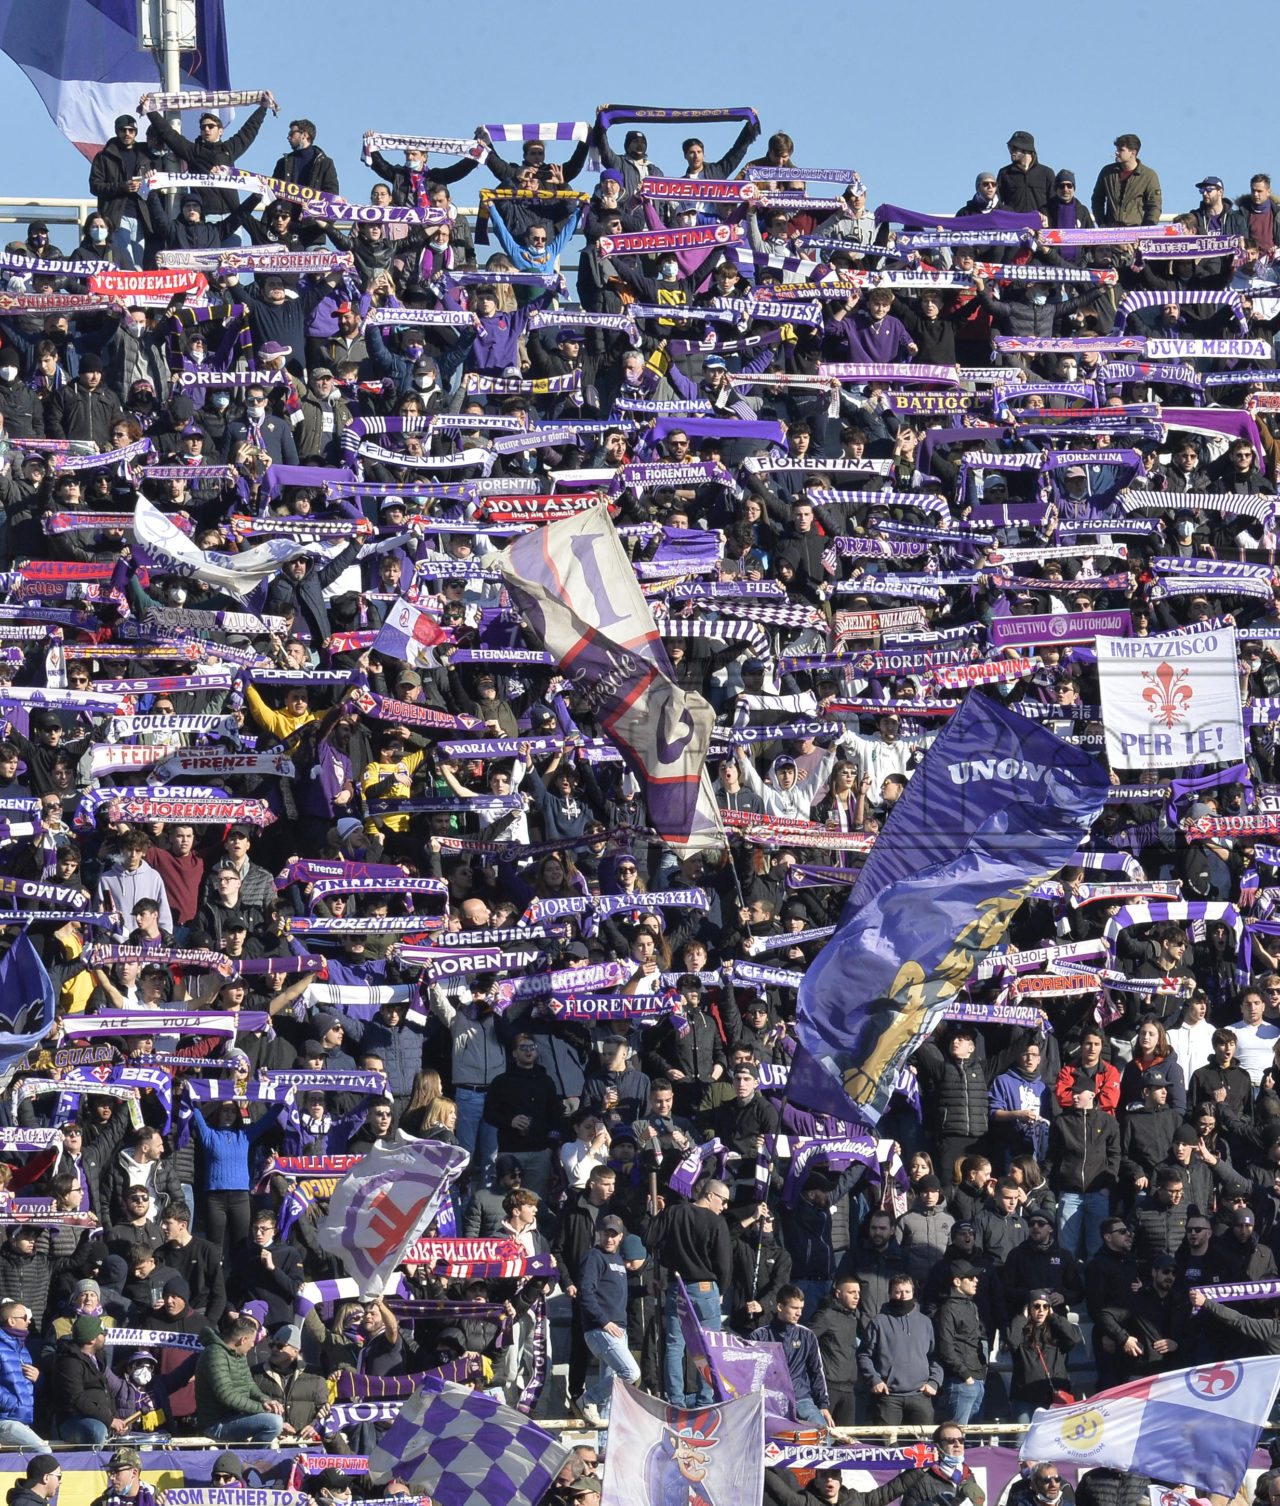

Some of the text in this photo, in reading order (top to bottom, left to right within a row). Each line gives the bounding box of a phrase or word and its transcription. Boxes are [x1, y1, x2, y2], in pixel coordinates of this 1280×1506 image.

[373, 136, 464, 154] FIORENTINA
[645, 181, 739, 199] FIORENTINA
[329, 204, 420, 223] VIOLA
[617, 230, 715, 249] FIORENTINA
[912, 231, 1019, 244] ACF FIORENTINA
[809, 236, 901, 256] ACF FIORENTINA
[1004, 264, 1091, 282] FIORENTINA
[441, 312, 473, 323] VIOLA
[1152, 340, 1265, 357] JUVE MERDA
[1206, 374, 1231, 384] ACF
[1008, 383, 1086, 394] FIORENTINA
[896, 396, 985, 409] BATIGOL
[366, 443, 466, 465] FIORENTINA
[1057, 453, 1123, 463] FIORENTINA
[757, 457, 874, 472] FIORENTINA
[632, 467, 706, 480] la FIORENTINA
[252, 519, 353, 533] COLLETTIVO
[1059, 519, 1152, 530] ACF FIORENTINA
[837, 581, 940, 598] ACF FIORENTINA
[997, 616, 1122, 636] COLLETTIVO AUTONOMO
[1110, 636, 1218, 657] IMPAZZISCO
[470, 649, 544, 661] ETERNAMENTE
[875, 649, 969, 669] FIORENTINA
[251, 669, 352, 680] FIORENTINA
[381, 701, 456, 724] FIORENTINA
[132, 714, 221, 730] COLLETTIVO
[765, 728, 784, 739] LA
[791, 723, 839, 738] VIOLA
[1122, 727, 1223, 756] PER TE!
[142, 803, 246, 818] FIORENTINA
[307, 863, 344, 876] Firenze
[22, 884, 86, 907] SIAMO
[314, 919, 420, 929] FIORENTINA
[100, 944, 112, 957] IN
[148, 946, 173, 959] ALLA
[565, 995, 675, 1014] FIORENTINA
[162, 1017, 201, 1027] VIOLA
[164, 1056, 217, 1065] FIORENTINA
[275, 1073, 376, 1088] FIORENTINA
[782, 1445, 905, 1462] FIORENTINA
[167, 1489, 292, 1505] ROM FATHER TO
